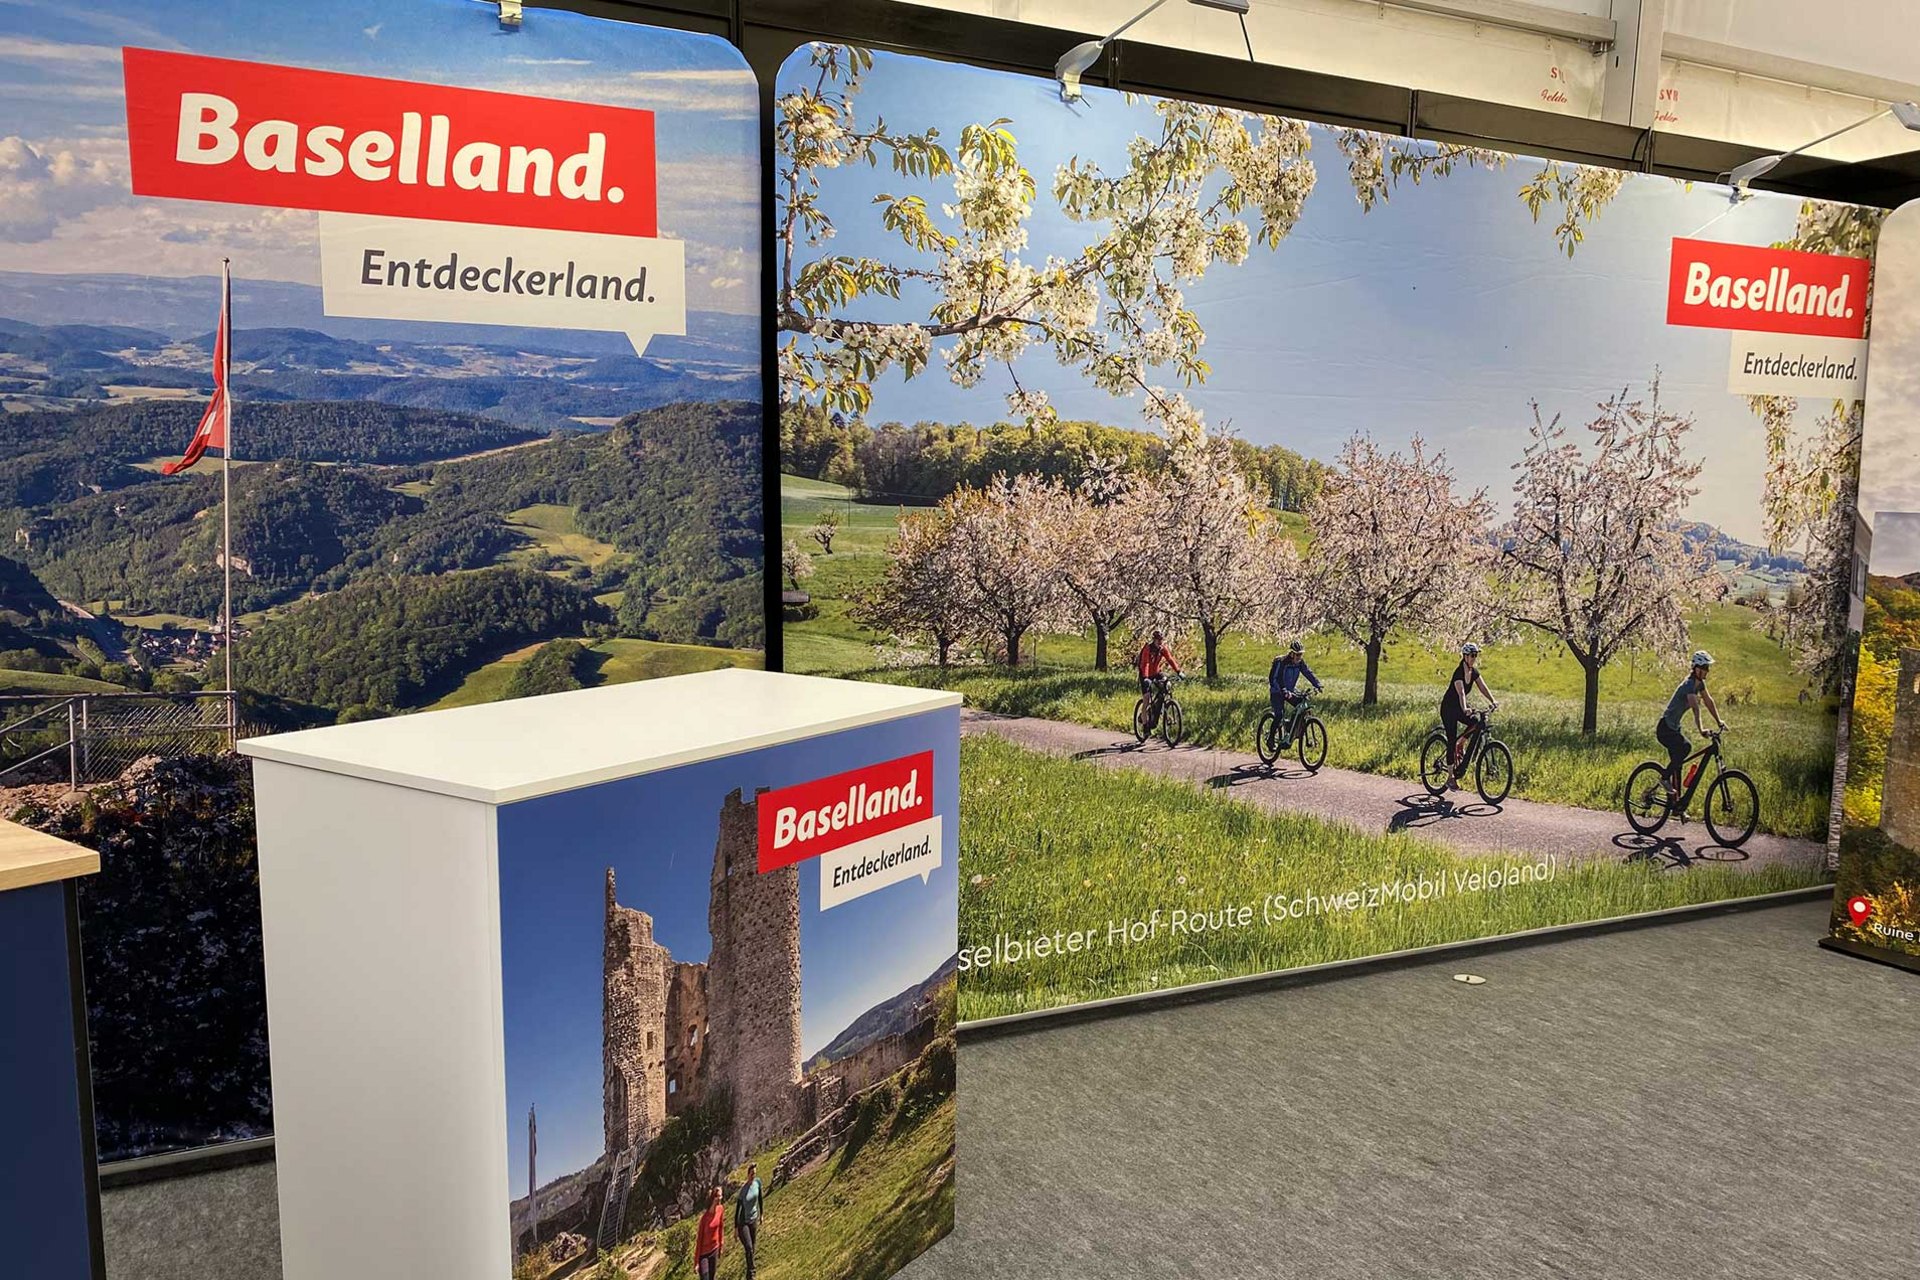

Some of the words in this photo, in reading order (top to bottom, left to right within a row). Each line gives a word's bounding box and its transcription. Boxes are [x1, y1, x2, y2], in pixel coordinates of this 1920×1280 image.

[175, 92, 626, 204] Baselland.
[360, 249, 656, 303] Entdeckerland.
[1683, 261, 1854, 319] Baselland.
[1743, 351, 1858, 381] Entdeckerland.
[773, 768, 923, 850] Baselland.
[832, 834, 932, 888] Entdeckerland.
[1107, 903, 1254, 947] Hof-Route
[1262, 869, 1448, 926] (SchweizMobil
[1453, 853, 1557, 893] Veloland)
[1873, 921, 1915, 942] Ruine
